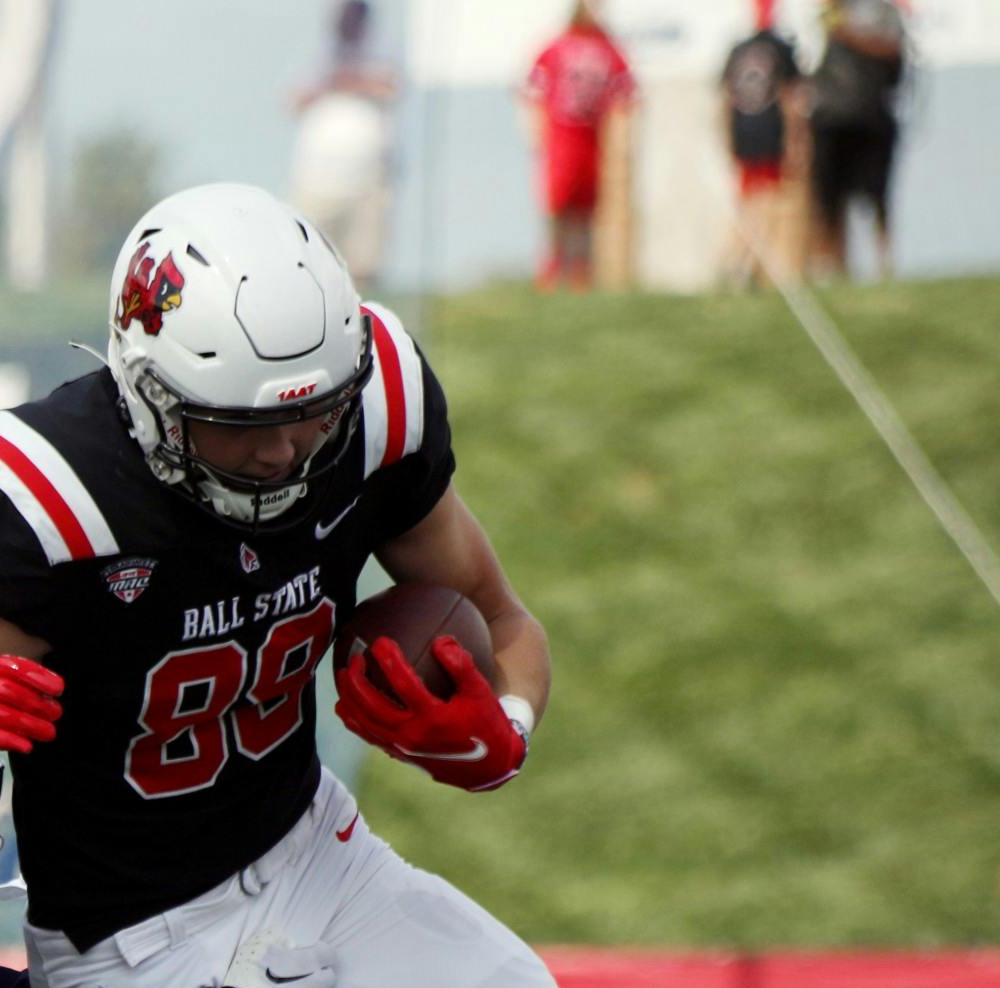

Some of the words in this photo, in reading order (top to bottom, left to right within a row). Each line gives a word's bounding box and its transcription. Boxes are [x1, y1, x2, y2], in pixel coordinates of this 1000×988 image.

[182, 596, 245, 641] BALL
[253, 566, 321, 622] STATE
[123, 596, 337, 801] 89
